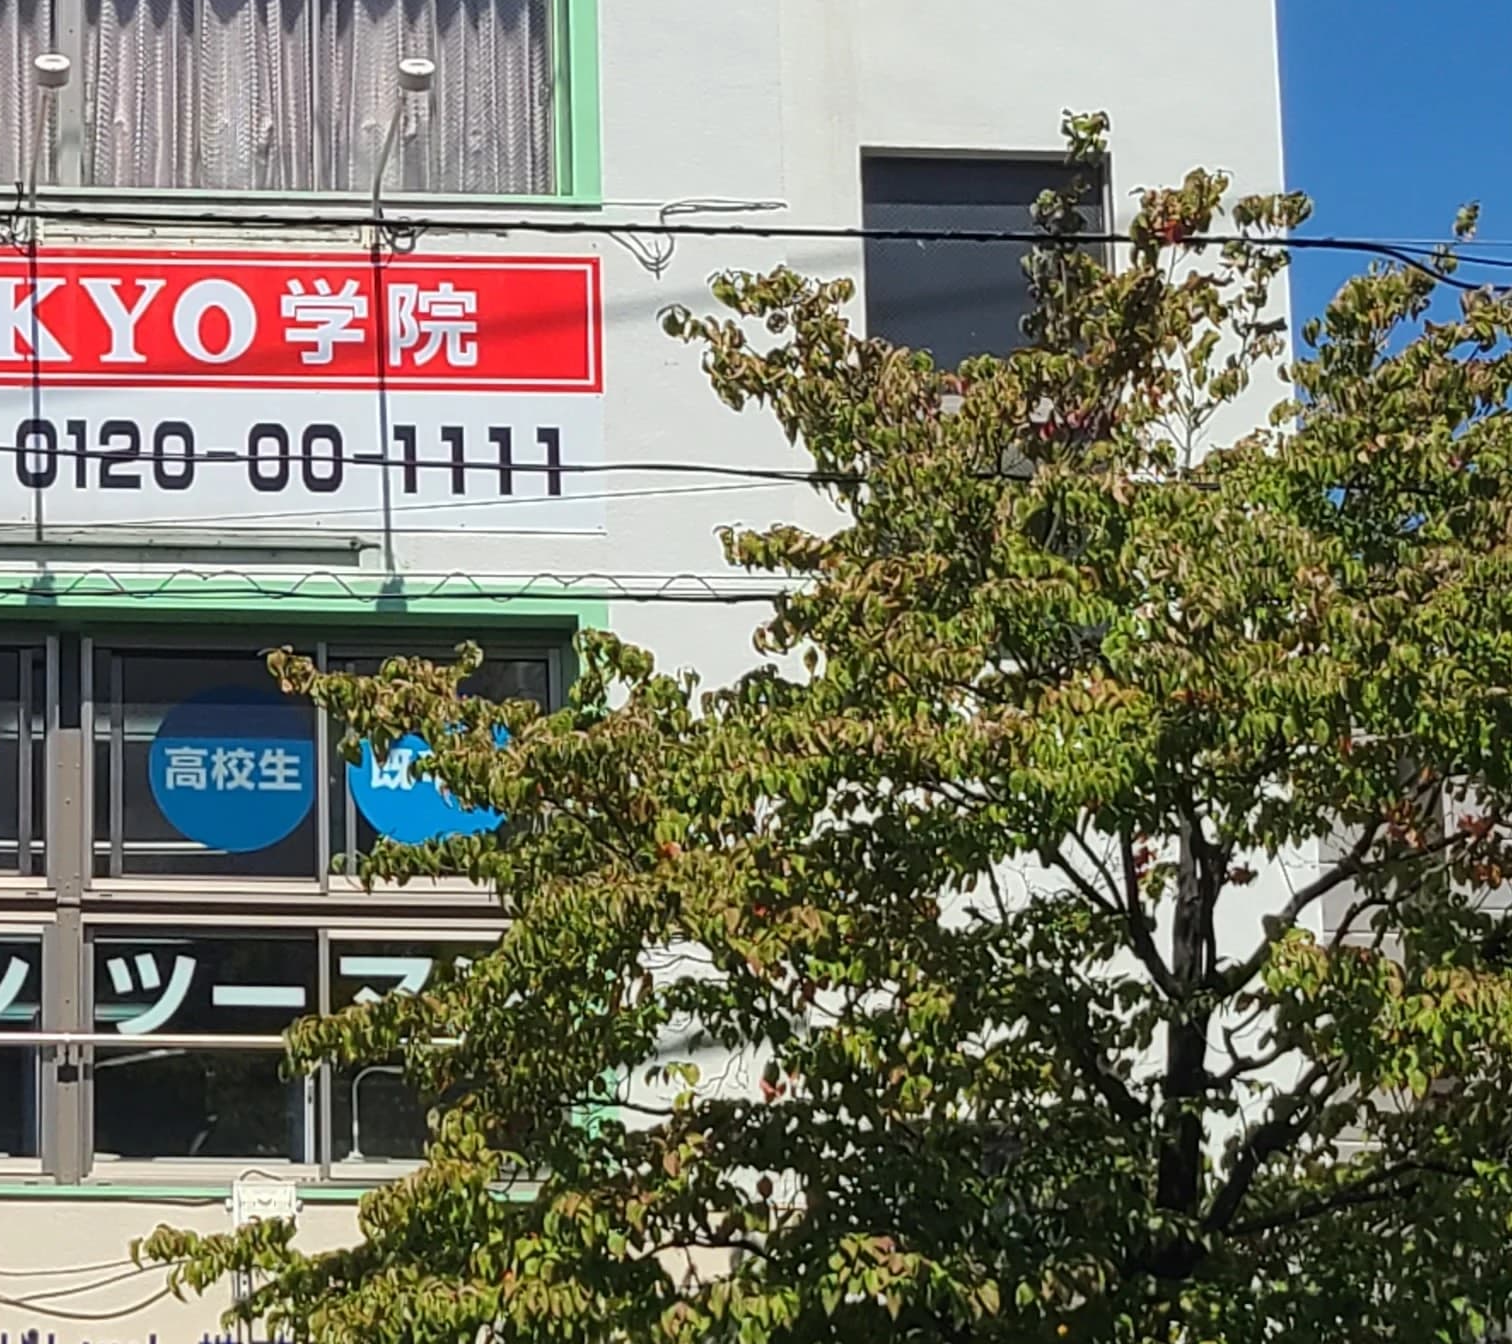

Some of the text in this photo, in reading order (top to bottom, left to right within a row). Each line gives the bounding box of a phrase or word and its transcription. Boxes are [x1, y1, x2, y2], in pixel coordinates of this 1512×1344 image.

[15, 420, 564, 498] 0120-00-1111
[164, 746, 303, 792] 高校生
